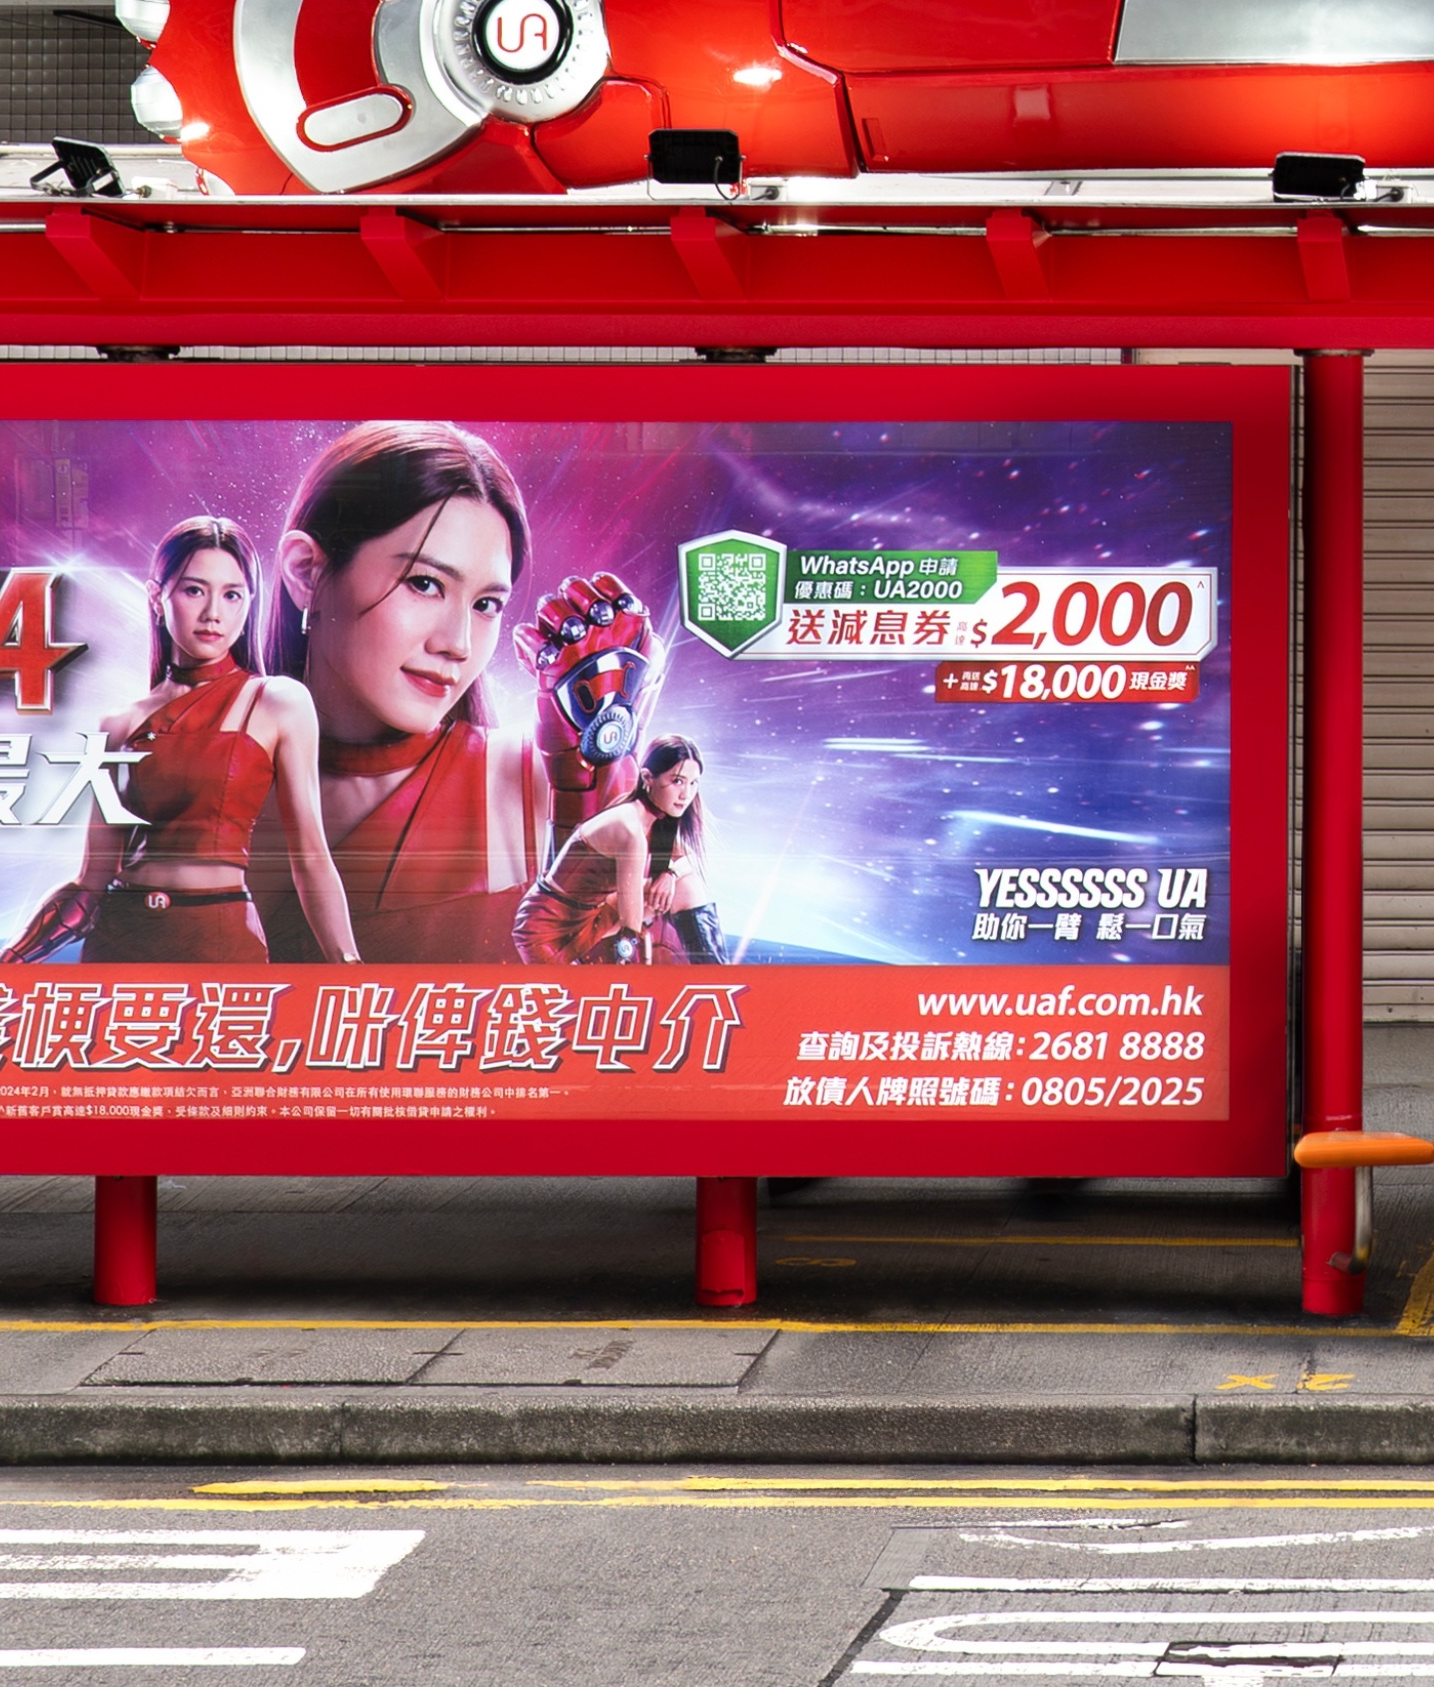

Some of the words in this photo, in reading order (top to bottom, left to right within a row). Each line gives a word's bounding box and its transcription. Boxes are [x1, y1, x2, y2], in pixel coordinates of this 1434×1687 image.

[497, 11, 548, 56] UA
[800, 555, 915, 578] WhatsApp
[919, 558, 958, 576] 申請
[982, 664, 1127, 701] $18,000
[974, 868, 1148, 909] YESSSSSS
[1158, 868, 1208, 909] UA
[971, 913, 1082, 941] 助你一臂
[918, 985, 1204, 1017] www.uaf.com.hk
